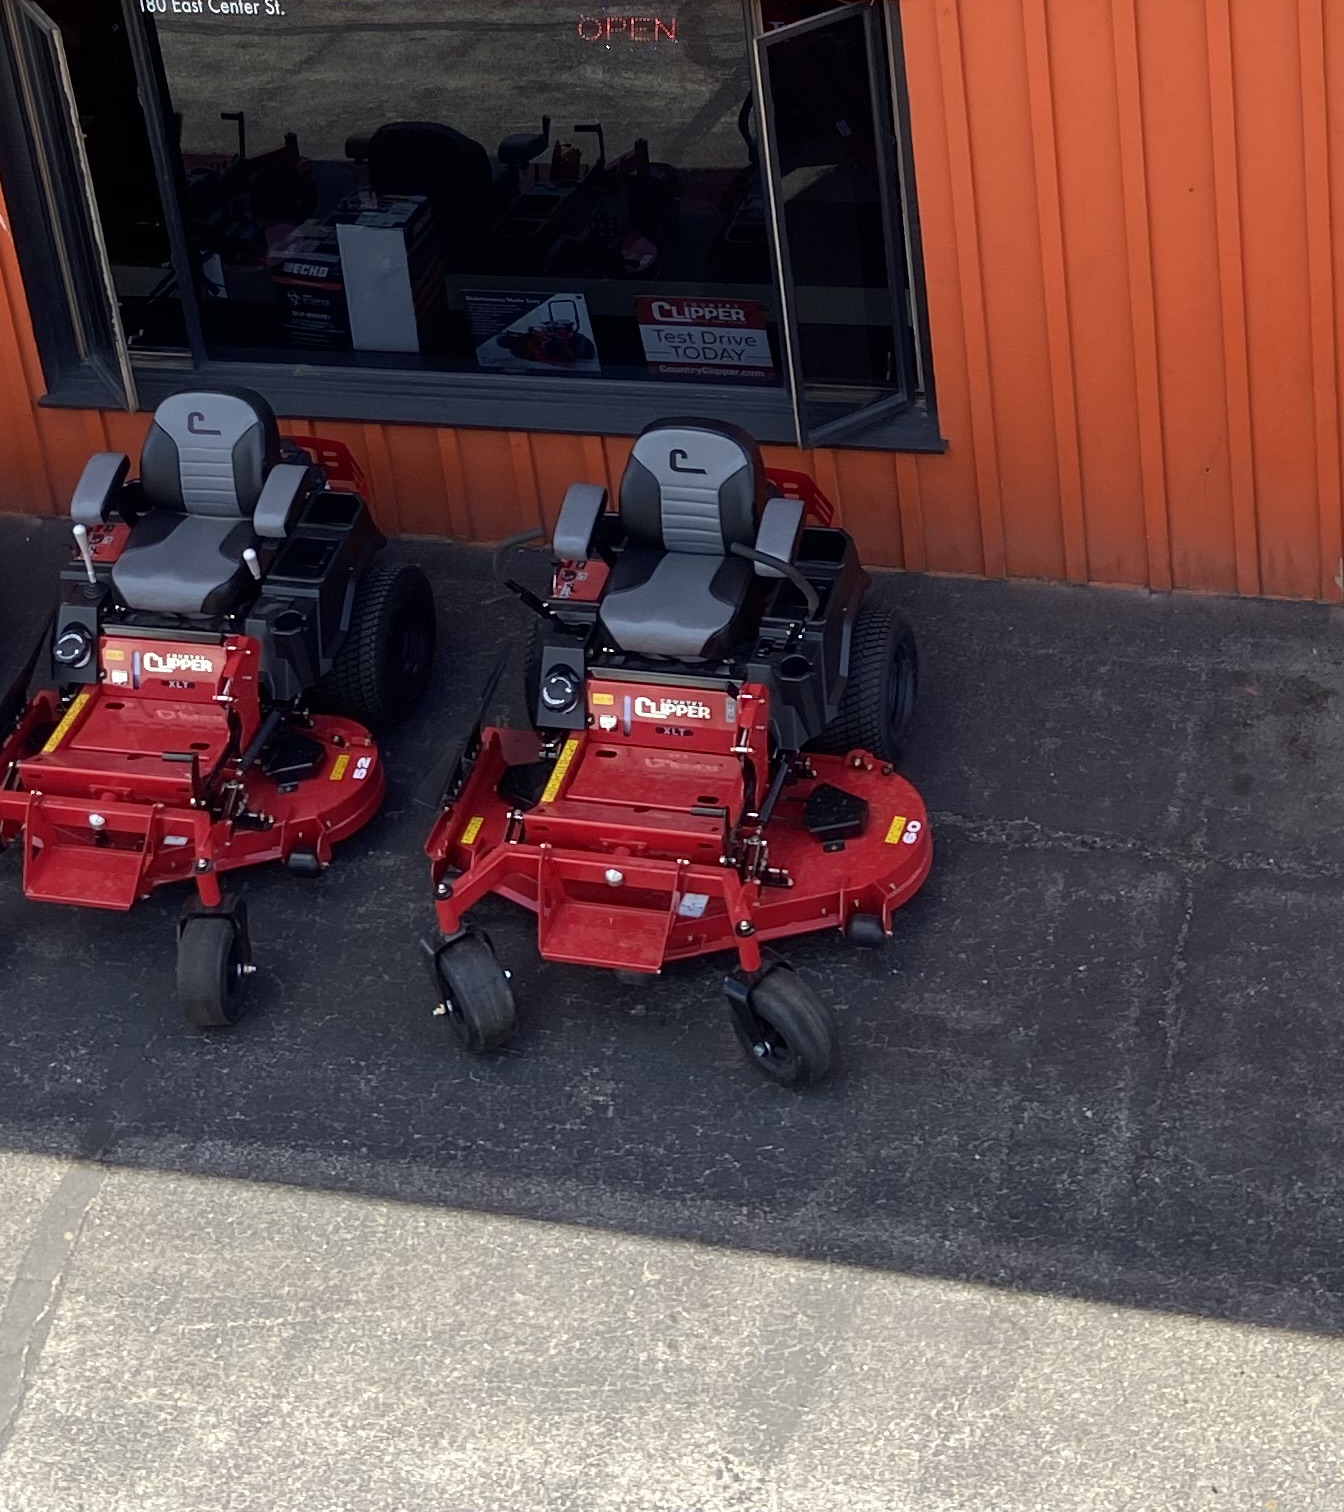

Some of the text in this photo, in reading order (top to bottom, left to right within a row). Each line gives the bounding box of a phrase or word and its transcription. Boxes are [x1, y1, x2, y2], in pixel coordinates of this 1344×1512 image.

[576, 16, 678, 41] OPEN
[293, 264, 329, 278] ECHO
[650, 300, 746, 323] CLIPPER
[652, 329, 757, 347] Test Drive
[670, 346, 745, 362] TODAY
[143, 652, 213, 673] CLIPPER
[168, 680, 189, 689] XLT
[634, 696, 711, 720] CLIPPER
[663, 727, 686, 736] XLT
